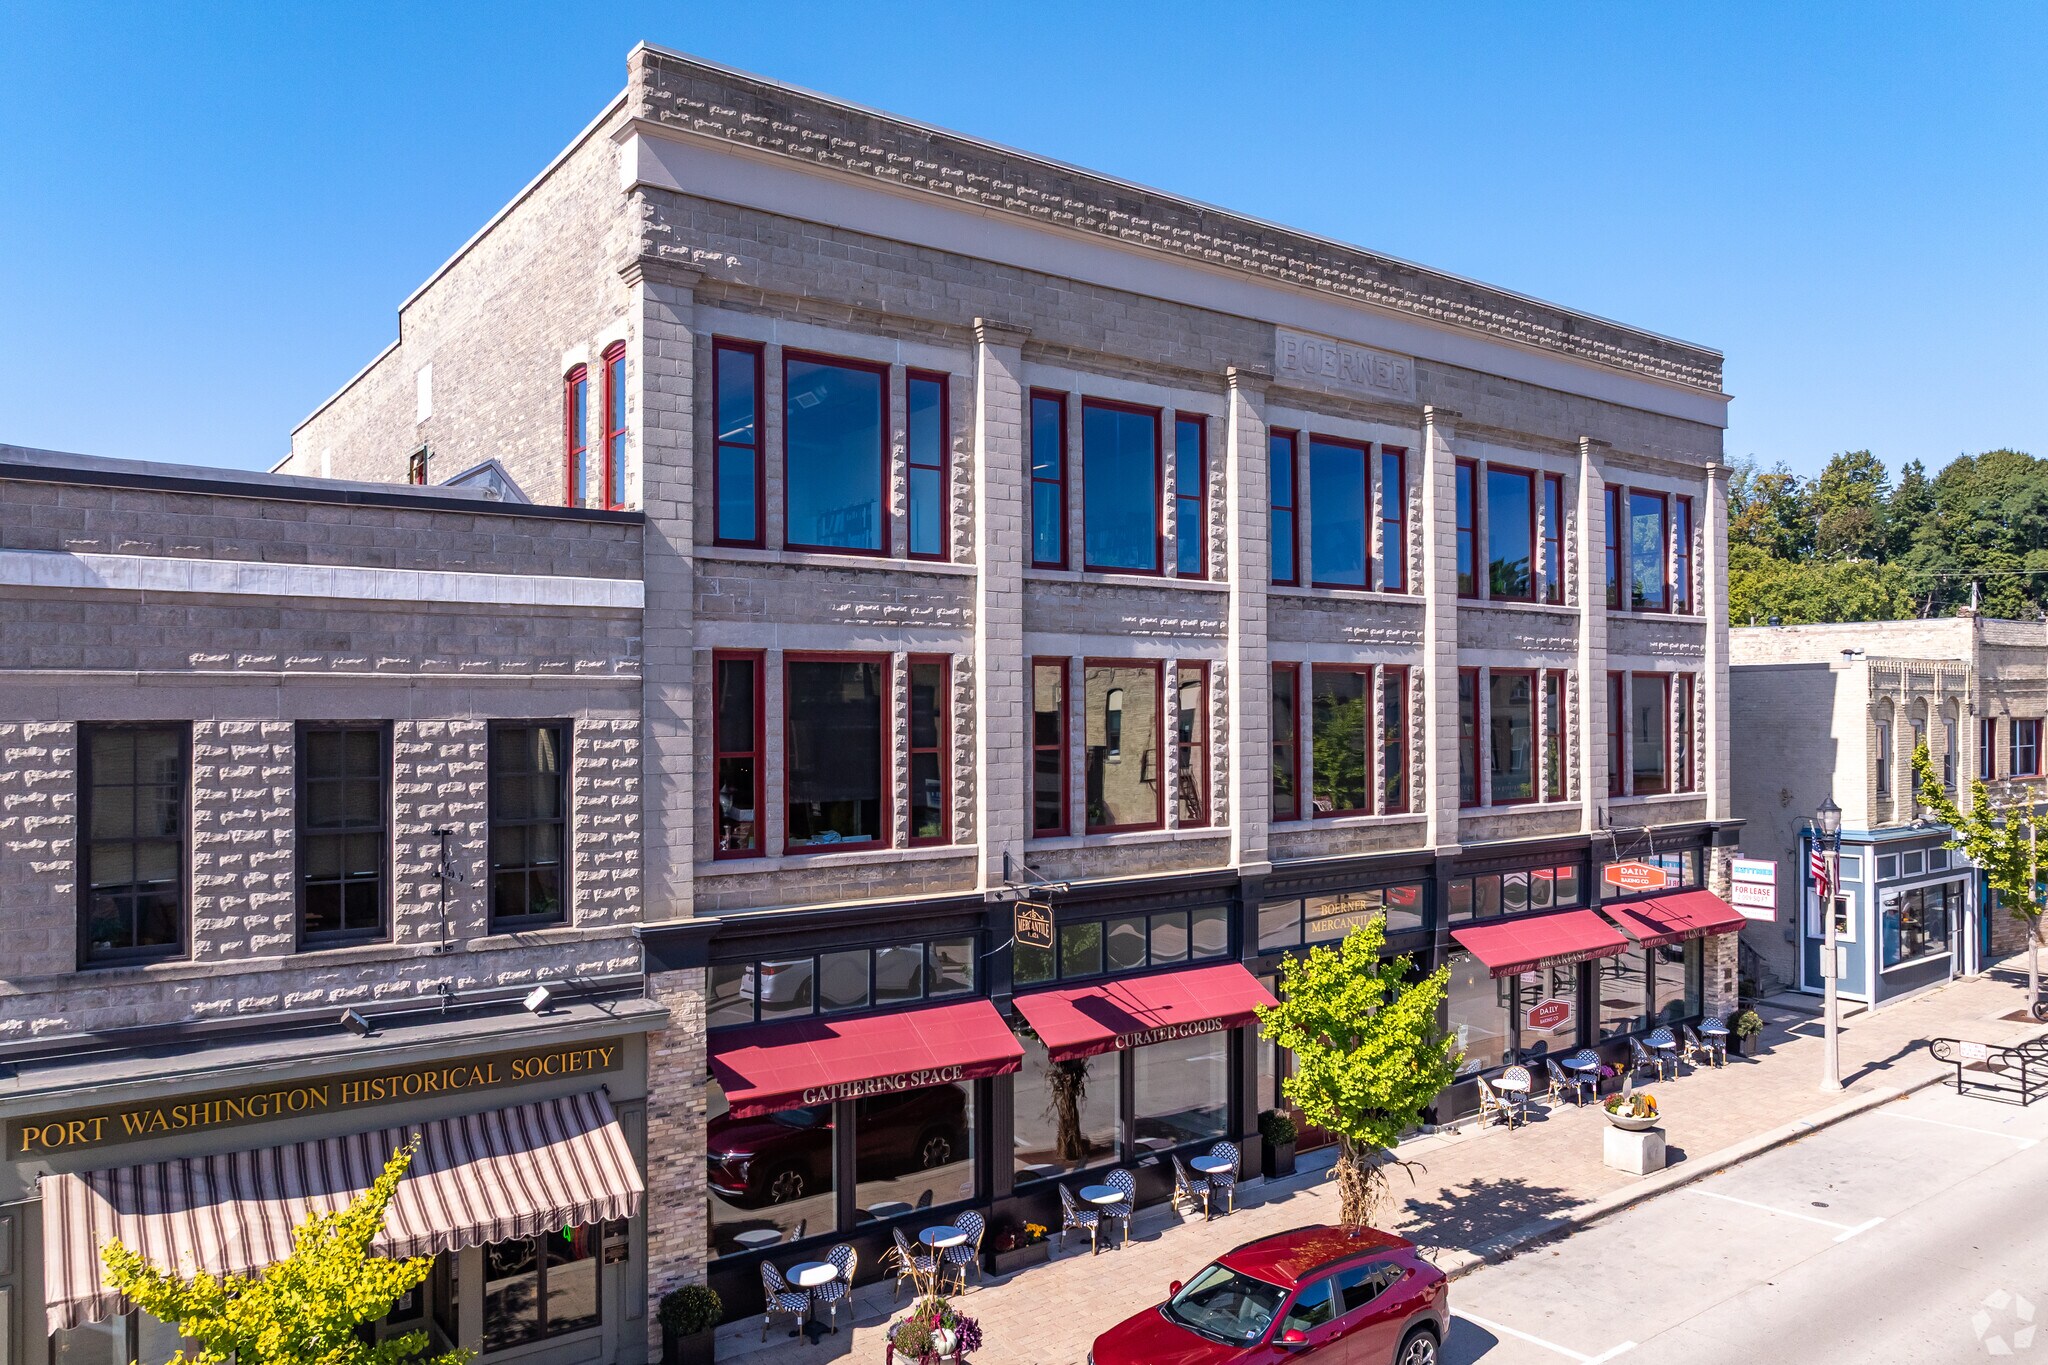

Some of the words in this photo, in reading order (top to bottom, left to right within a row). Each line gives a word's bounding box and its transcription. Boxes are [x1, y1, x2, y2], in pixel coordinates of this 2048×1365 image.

[1281, 336, 1408, 394] BOERNER
[1620, 867, 1649, 876] DAILY
[1735, 886, 1748, 894] FOR
[1749, 888, 1771, 897] LEASE
[1321, 900, 1367, 916] BOERNER
[1017, 918, 1050, 938] MERCANTILE
[1684, 926, 1708, 940] LUNCH
[1540, 951, 1587, 968] BREAKFAST
[1539, 1005, 1559, 1016] DAILY
[1115, 1025, 1177, 1049] CURATED
[1179, 1017, 1223, 1037] GOODS
[802, 1075, 906, 1104] GATHERING
[910, 1065, 963, 1087] SPACE
[20, 1116, 109, 1152] PORT
[120, 1084, 330, 1136] WASHINGTON
[340, 1063, 501, 1105] HISTORICAL
[511, 1046, 615, 1081] SOCIETY
